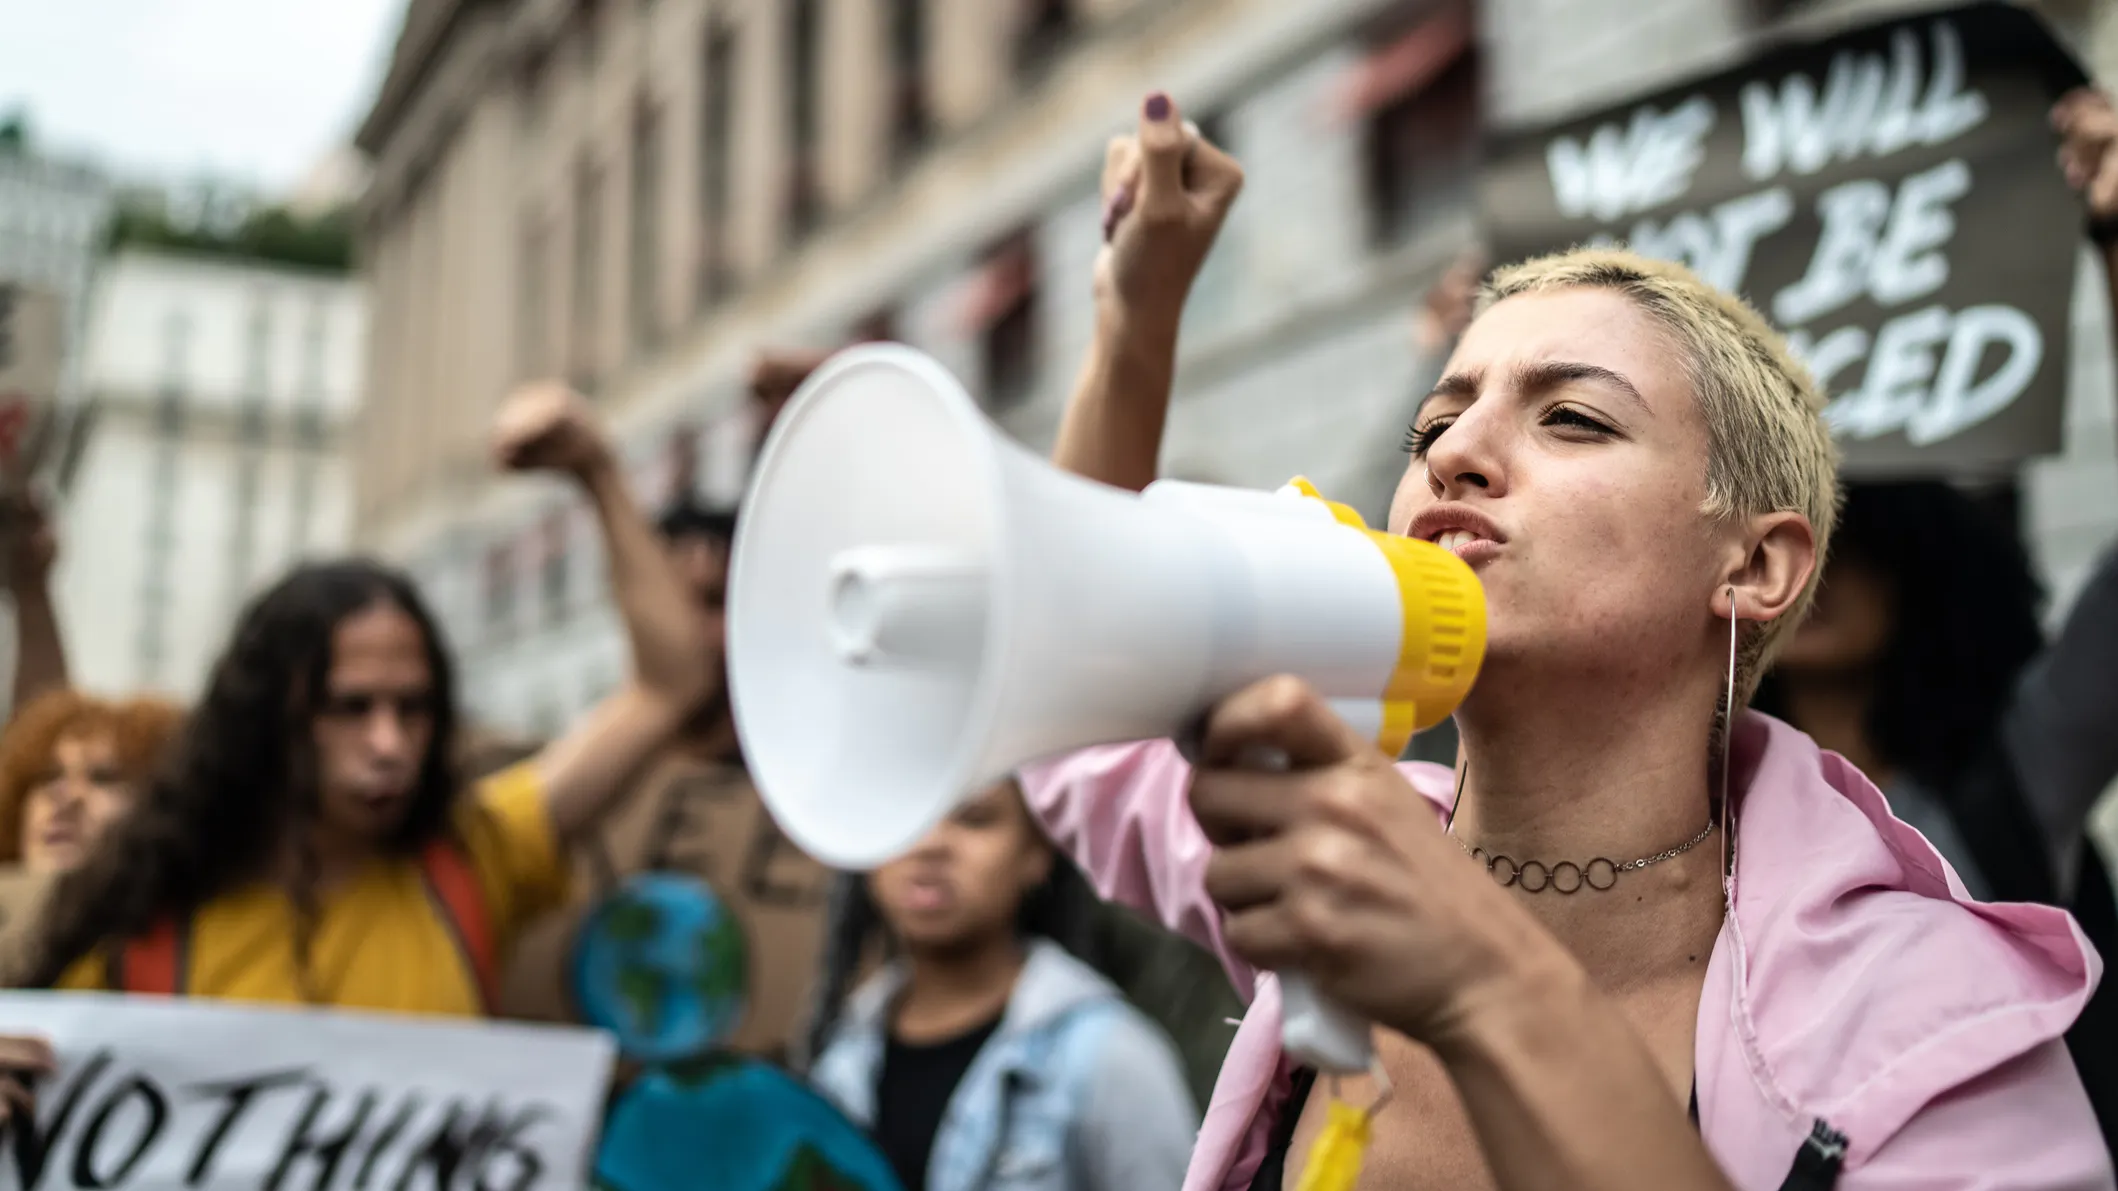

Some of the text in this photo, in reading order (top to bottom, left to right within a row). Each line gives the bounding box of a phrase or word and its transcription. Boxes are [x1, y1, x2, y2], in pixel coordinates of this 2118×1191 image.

[1545, 20, 1990, 221] WE WILL
[1771, 157, 1973, 328] BE
